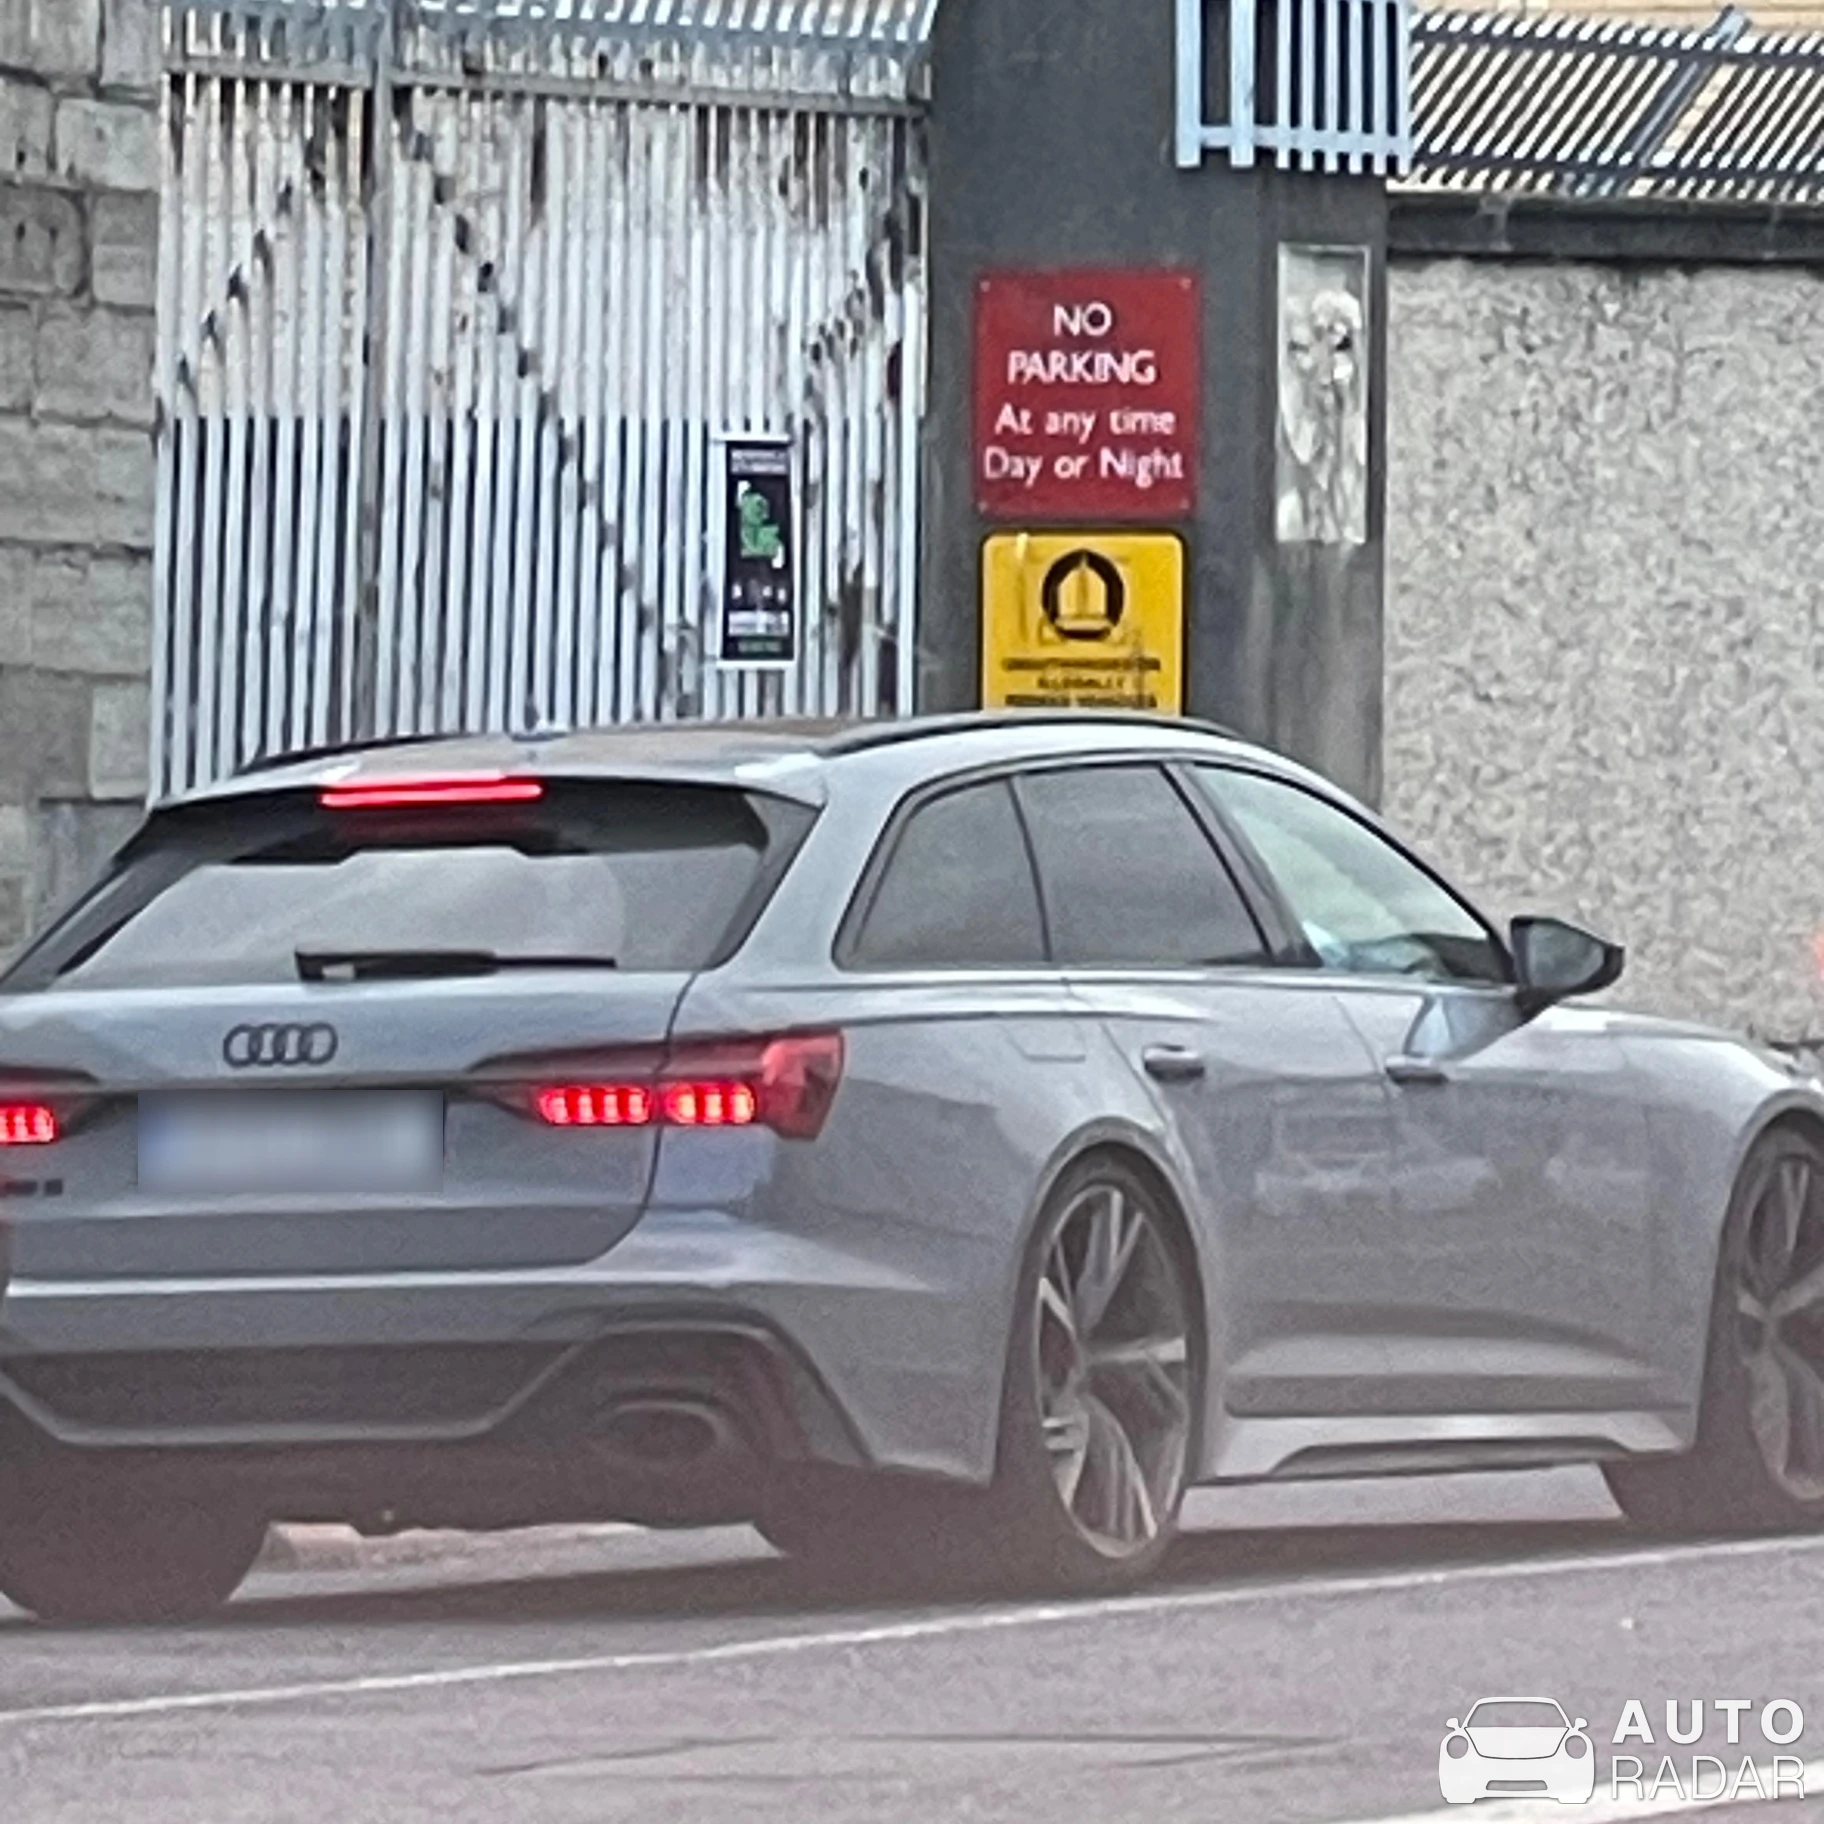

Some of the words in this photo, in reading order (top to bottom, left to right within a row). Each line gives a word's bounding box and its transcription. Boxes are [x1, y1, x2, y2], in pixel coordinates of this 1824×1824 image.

[1054, 302, 1111, 336] NO
[1008, 350, 1156, 383] PARKING
[995, 403, 1033, 435] At
[1045, 412, 1096, 444] any
[1110, 408, 1176, 435] time
[984, 447, 1043, 487] Day
[1054, 456, 1090, 479] or
[1100, 446, 1184, 488] Night
